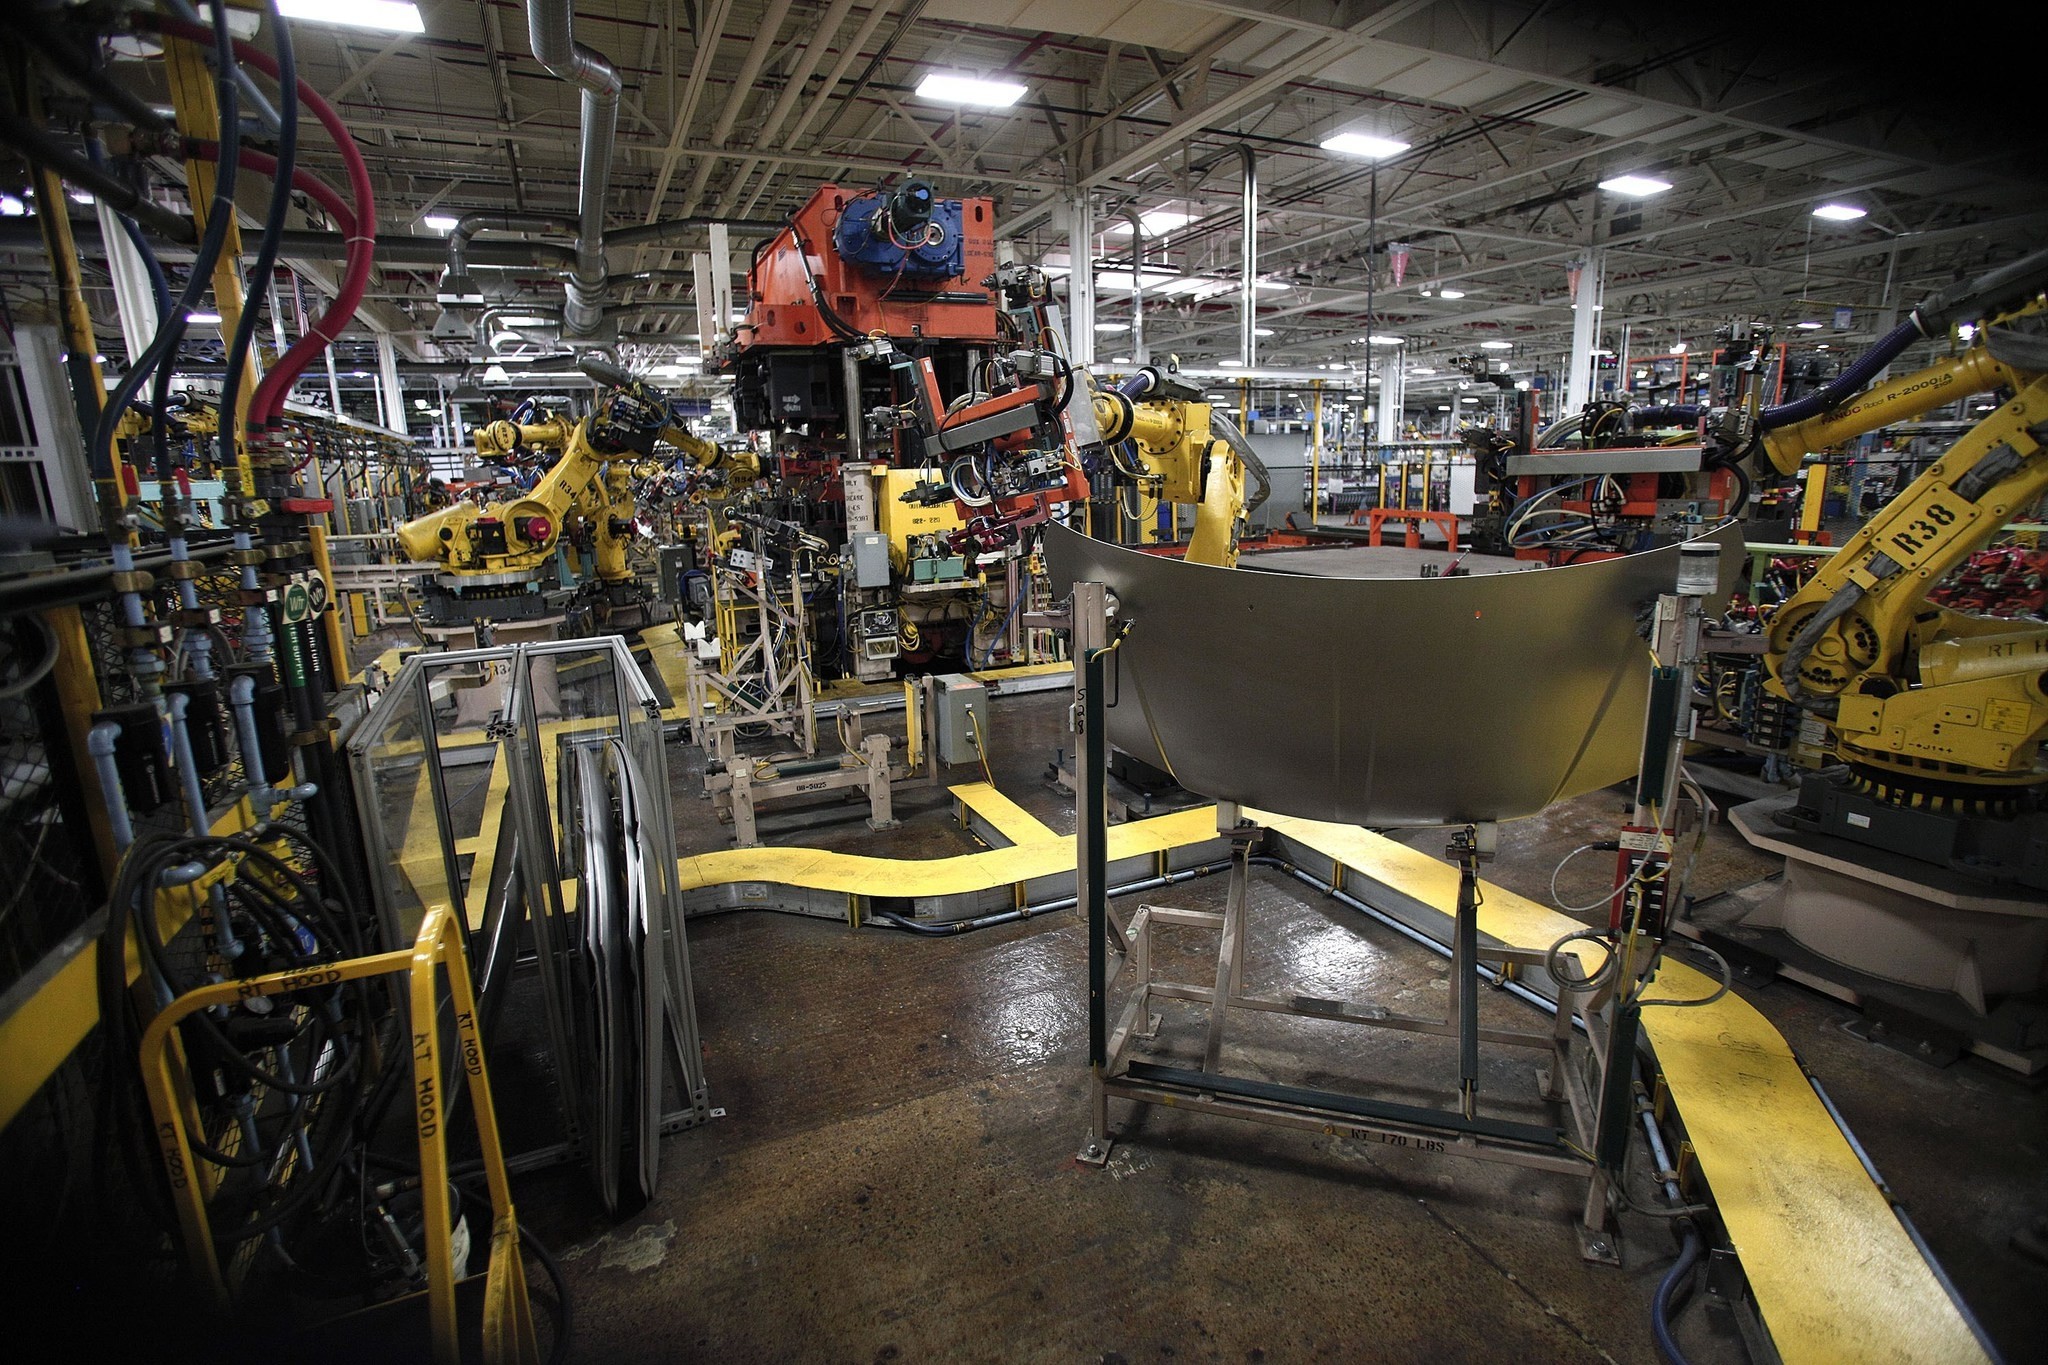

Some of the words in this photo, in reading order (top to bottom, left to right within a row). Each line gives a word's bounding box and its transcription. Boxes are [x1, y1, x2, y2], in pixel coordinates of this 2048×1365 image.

[1821, 406, 1862, 425] FANUC
[559, 479, 578, 499] R34
[1891, 504, 1956, 556] R38
[292, 645, 305, 680] SUPPLY
[308, 636, 320, 672] RETURN
[1988, 641, 2019, 658] RT
[238, 982, 267, 997] RT
[281, 970, 341, 991] HOOD
[457, 1010, 474, 1031] RT
[414, 1033, 432, 1062] RT
[464, 1039, 482, 1076] HOOD
[418, 1078, 437, 1138] HOOD
[1382, 1133, 1407, 1146] 170
[1416, 1138, 1445, 1153] LBS
